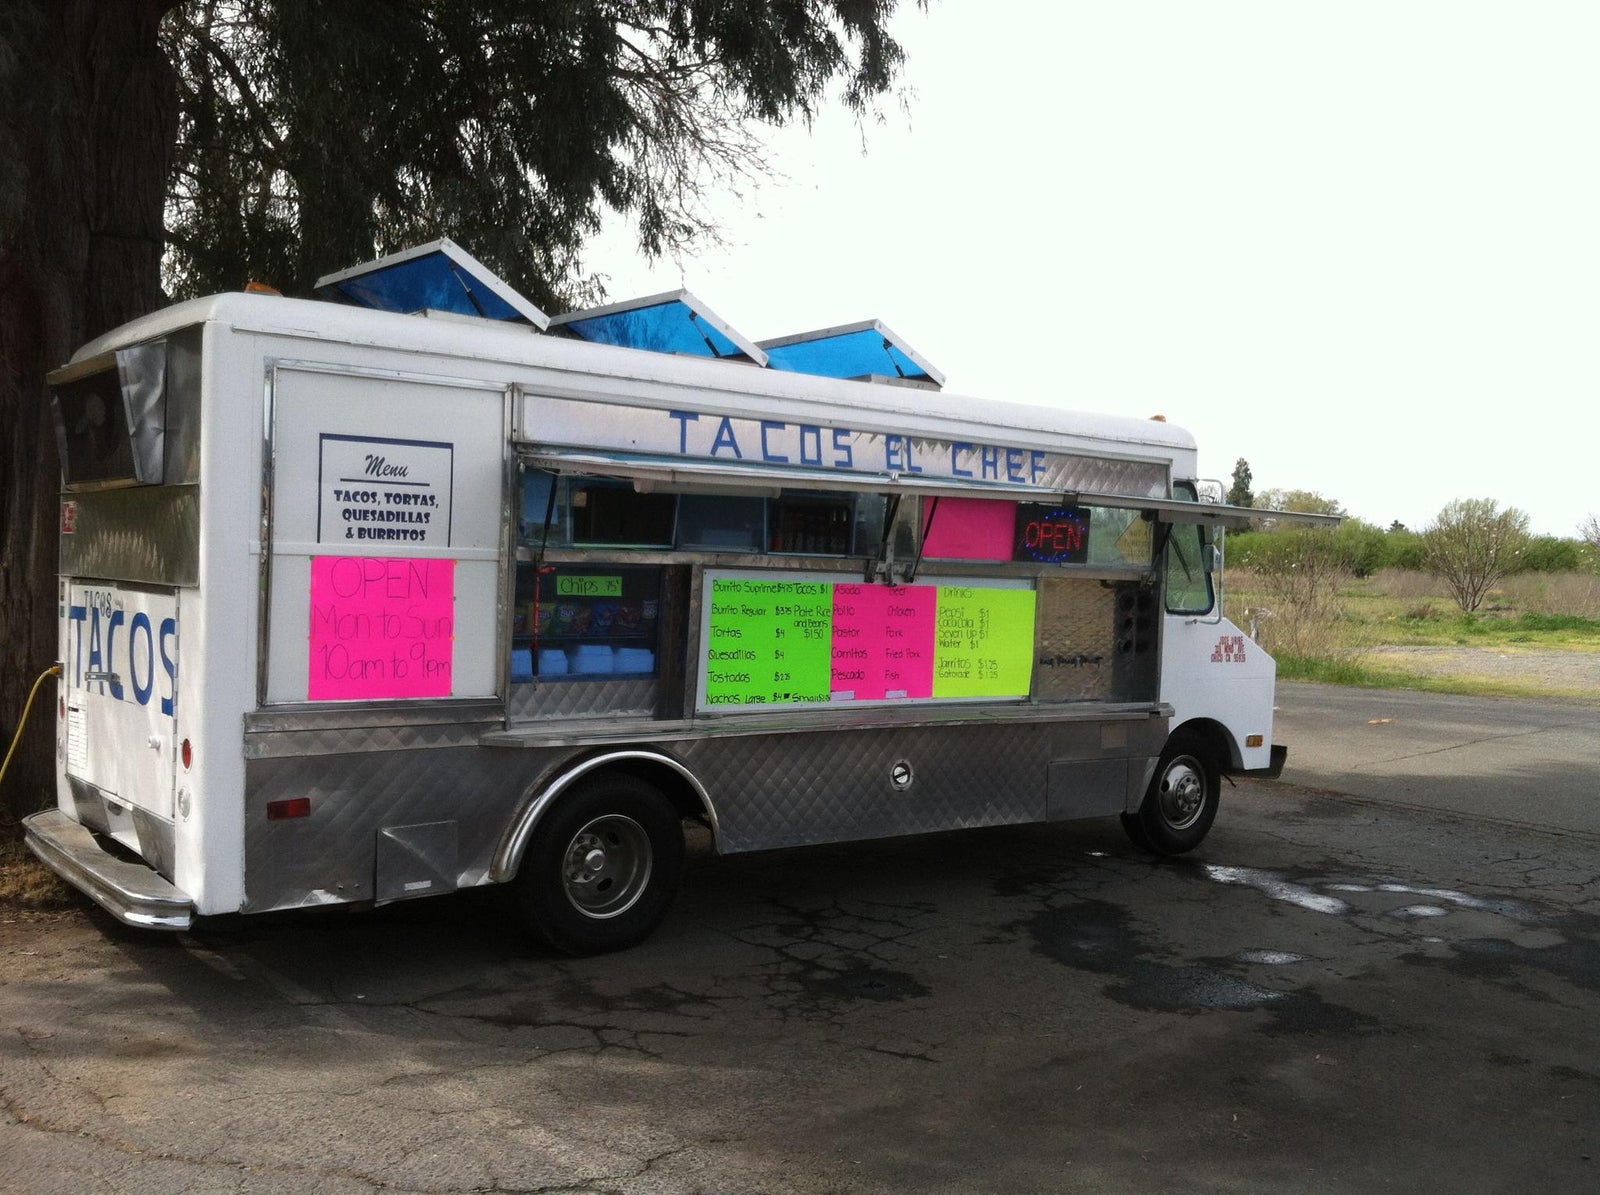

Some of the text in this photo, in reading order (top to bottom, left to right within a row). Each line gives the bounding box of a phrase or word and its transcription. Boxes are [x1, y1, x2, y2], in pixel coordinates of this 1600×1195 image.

[669, 410, 1047, 484] TACOS EL CHEF
[364, 453, 409, 478] Menu
[333, 489, 439, 509] TACOS, TORTAS,
[342, 508, 430, 524] QUESADILLAS
[345, 526, 426, 541] & BURRITOS
[1025, 520, 1082, 550] OPEN
[330, 557, 429, 600] OPEN
[560, 577, 599, 594] Chips
[712, 579, 742, 593] Burrito
[793, 582, 817, 595] Tacos
[711, 603, 739, 616] Burrito
[381, 607, 400, 640] to
[405, 604, 451, 641] Sun
[711, 626, 785, 639] Tortas $4
[939, 639, 961, 649] Water
[69, 605, 176, 717] TACOS
[320, 642, 451, 681] 10am to 9pm
[708, 649, 785, 661] Quesadillas $4
[707, 671, 751, 683] Tostadas
[705, 692, 741, 705] Nachos
